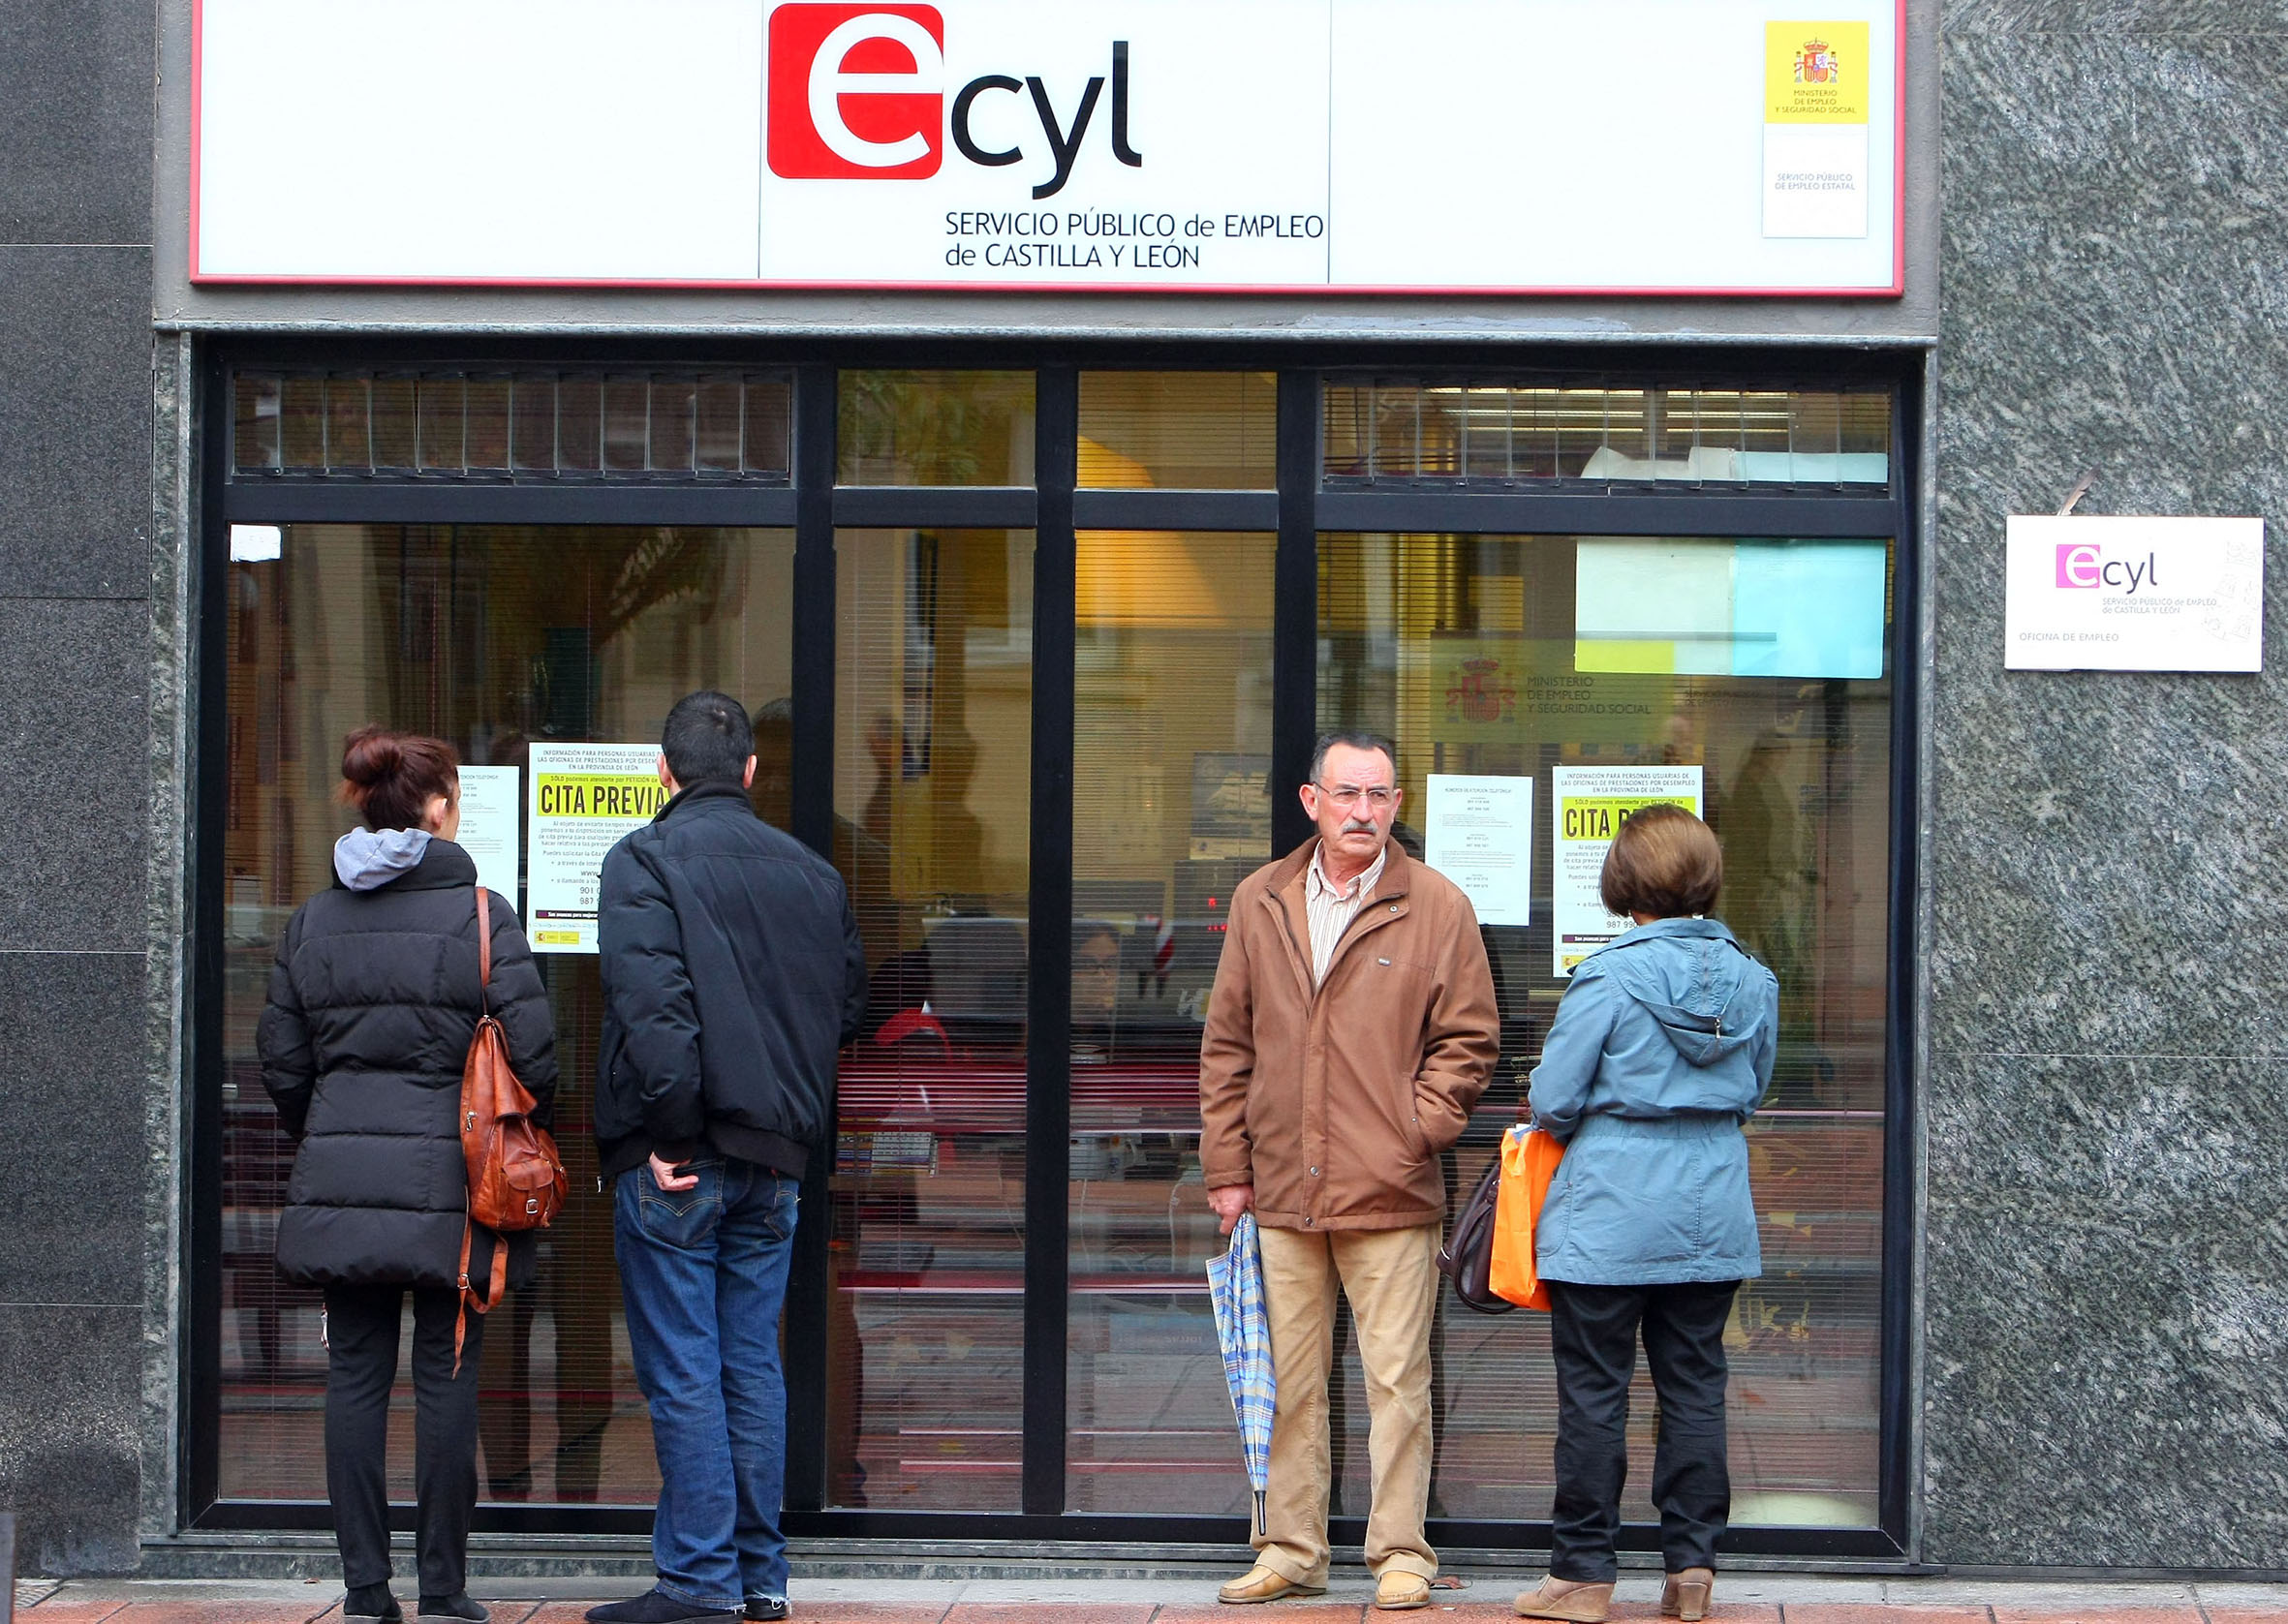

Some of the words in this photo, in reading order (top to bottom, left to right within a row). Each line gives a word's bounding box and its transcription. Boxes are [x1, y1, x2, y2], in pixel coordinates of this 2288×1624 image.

[808, 13, 1142, 200] ecyl
[1816, 172, 1853, 182] PÚBLICO
[945, 212, 1059, 236] SERVICIO
[1067, 206, 1176, 237] PÚBLICO
[1184, 214, 1215, 237] de
[1225, 215, 1324, 238] EMPLEO
[945, 243, 975, 266] de
[985, 244, 1102, 267] CASTILLA
[1108, 245, 1125, 267] Y
[1134, 238, 1200, 268] LEÓN
[2066, 546, 2157, 595] ecyl
[2140, 598, 2173, 606] PÚBLICO
[2159, 605, 2180, 614] LEÓN
[2020, 632, 2059, 641] OFICINA
[2080, 633, 2119, 642] EMPLEO
[1528, 677, 1593, 687] MINISTERIO
[1528, 690, 1545, 700] DE
[1546, 690, 1591, 700] EMPLEO
[1528, 704, 1535, 713] Y
[1537, 704, 1605, 714] SEGURIDAD
[1609, 704, 1652, 715] SOCIAL
[541, 784, 585, 814] CITA
[594, 786, 665, 814] PREVIA
[1565, 809, 1611, 838] CITA
